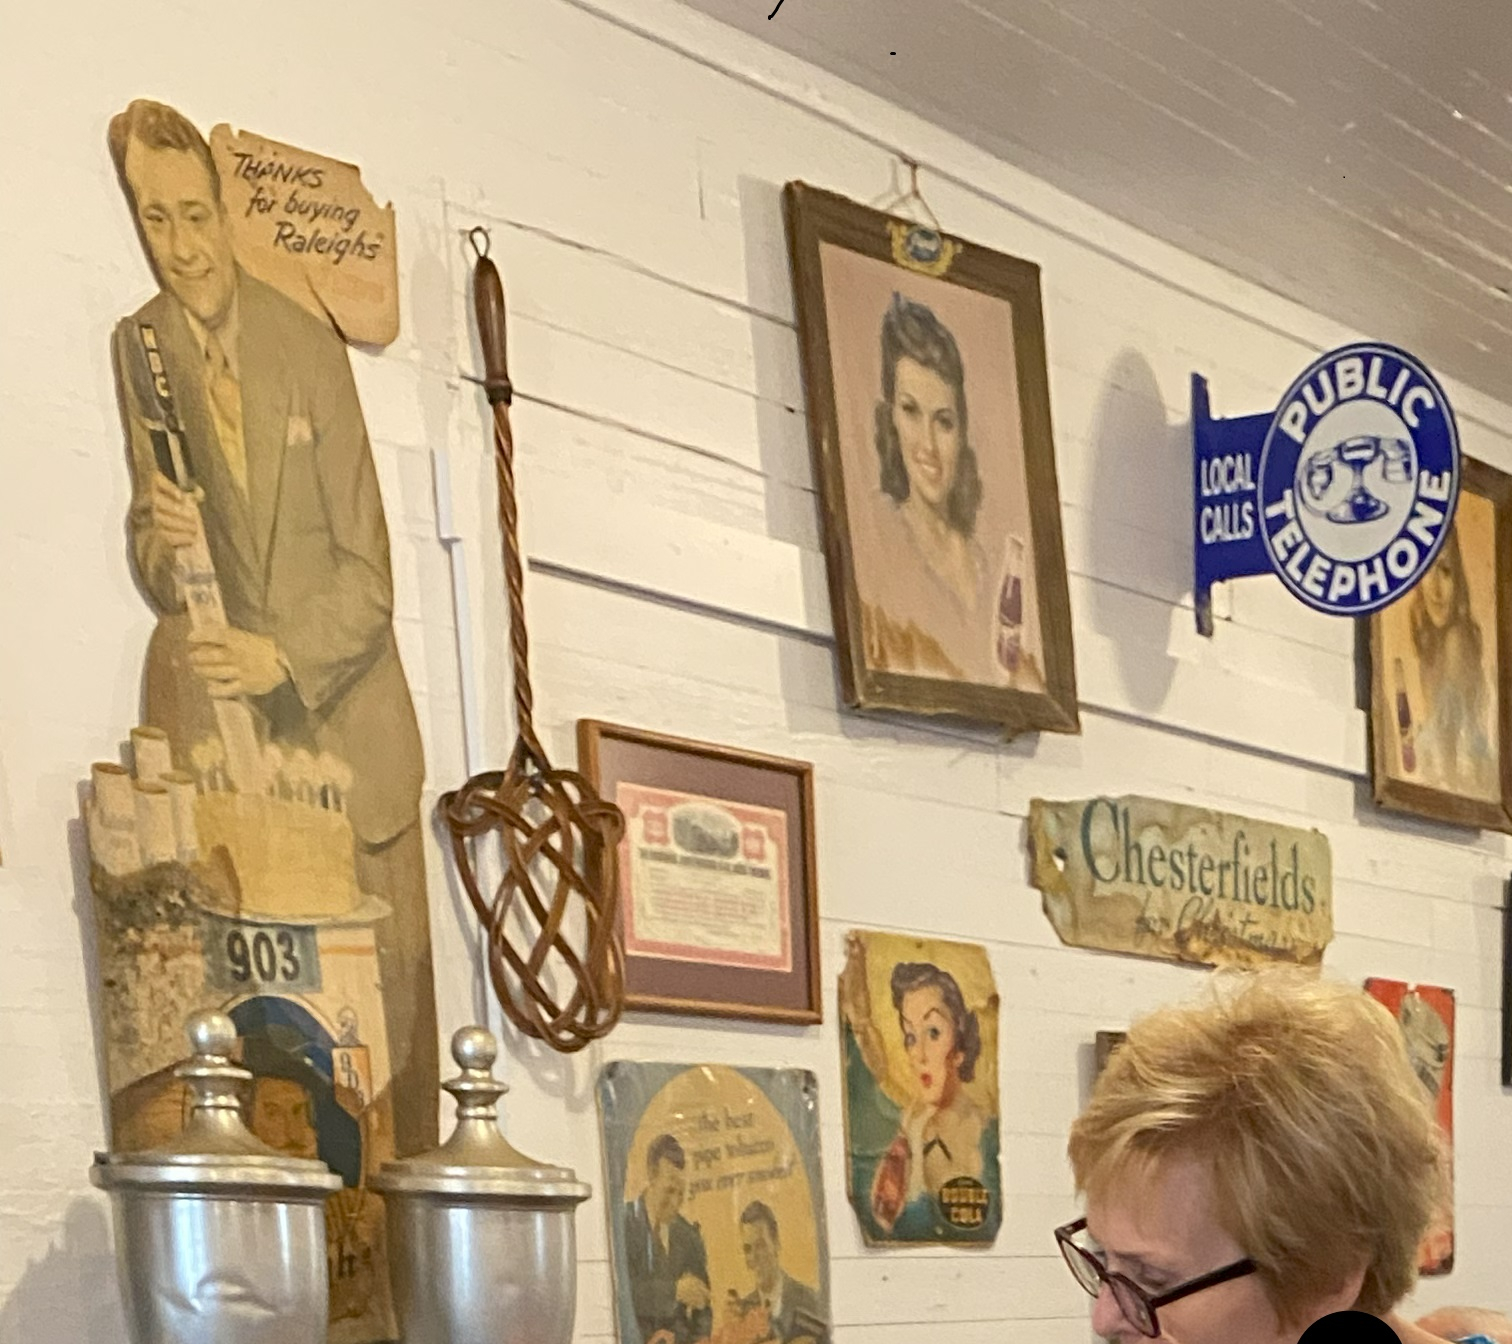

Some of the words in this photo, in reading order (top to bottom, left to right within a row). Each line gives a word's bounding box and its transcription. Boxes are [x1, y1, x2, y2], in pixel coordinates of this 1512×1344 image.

[233, 152, 324, 188] THANKS
[245, 186, 276, 218] for
[284, 189, 360, 232] buying
[1279, 356, 1435, 444] PUBLIC
[1200, 453, 1256, 497] LOCAL
[1201, 501, 1255, 545] CALLS
[1265, 469, 1451, 601] TELEPHONE
[1080, 798, 1317, 914] Chesterfields
[226, 929, 301, 982] 903
